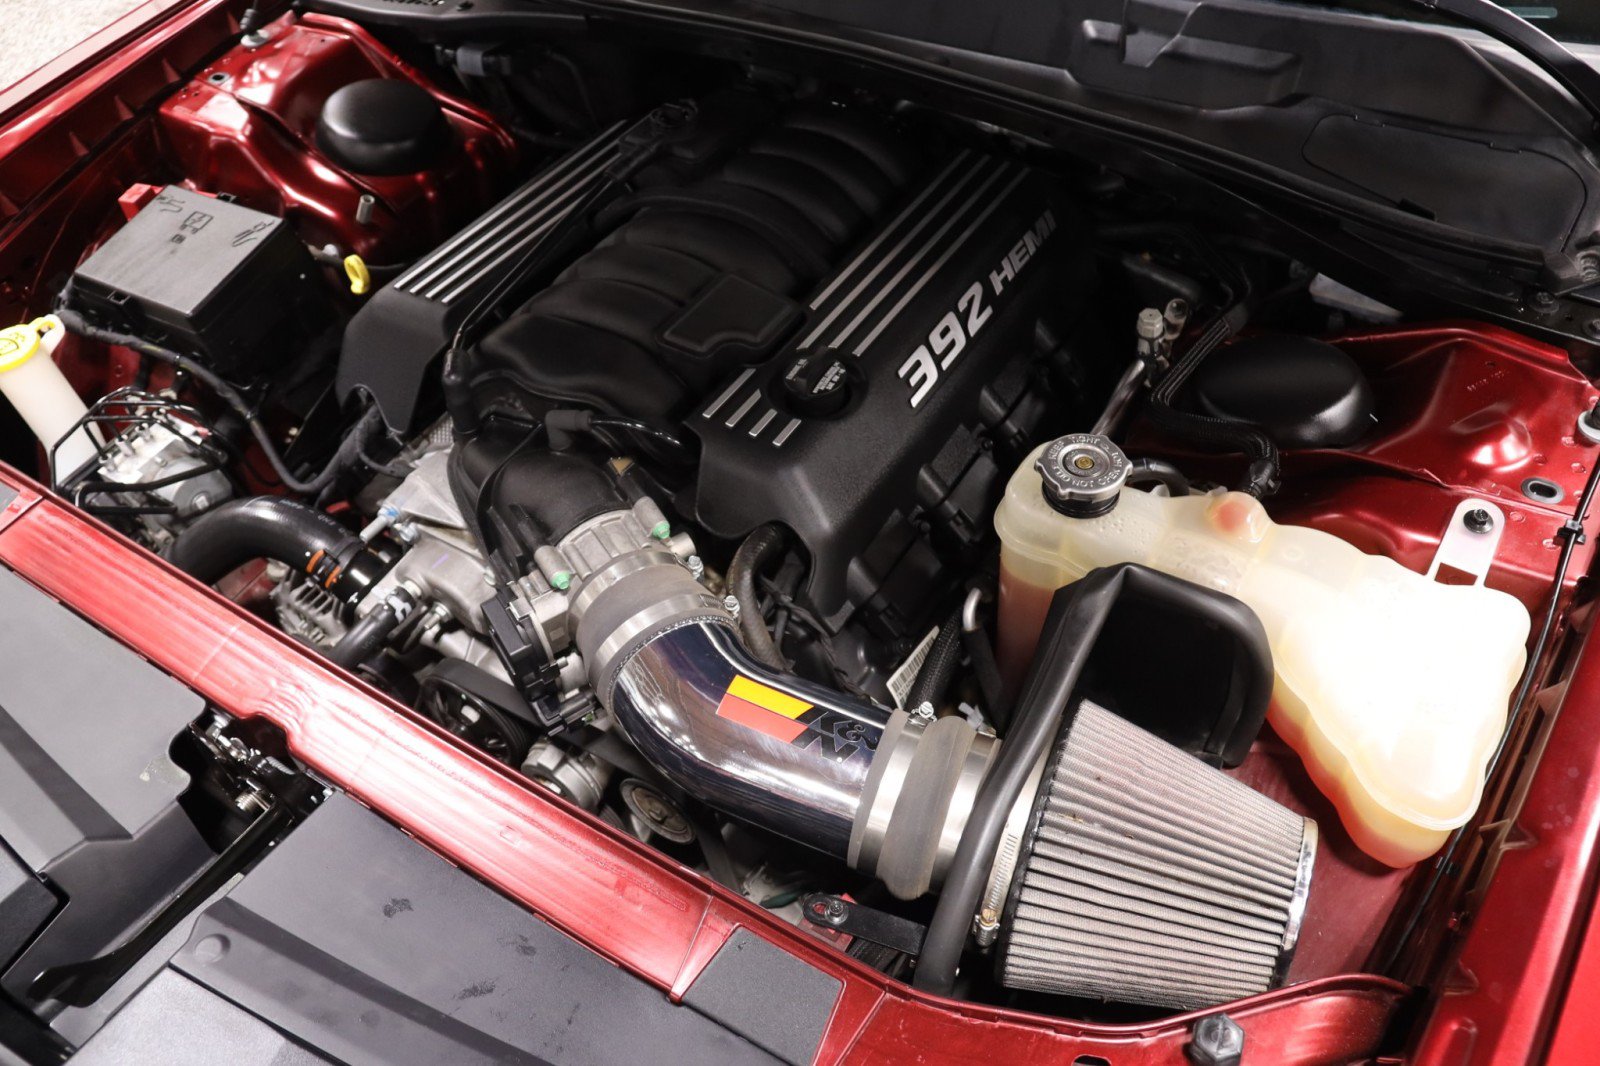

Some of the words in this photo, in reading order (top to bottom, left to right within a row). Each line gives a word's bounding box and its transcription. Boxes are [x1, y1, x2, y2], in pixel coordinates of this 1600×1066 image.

[897, 281, 993, 408] 392
[989, 208, 1056, 296] HEMI
[1048, 440, 1065, 460] KEEP
[1068, 435, 1100, 444] TIGHT
[1072, 480, 1094, 488] NOT
[1098, 469, 1121, 486] OPEN
[1111, 452, 1123, 468] HOT
